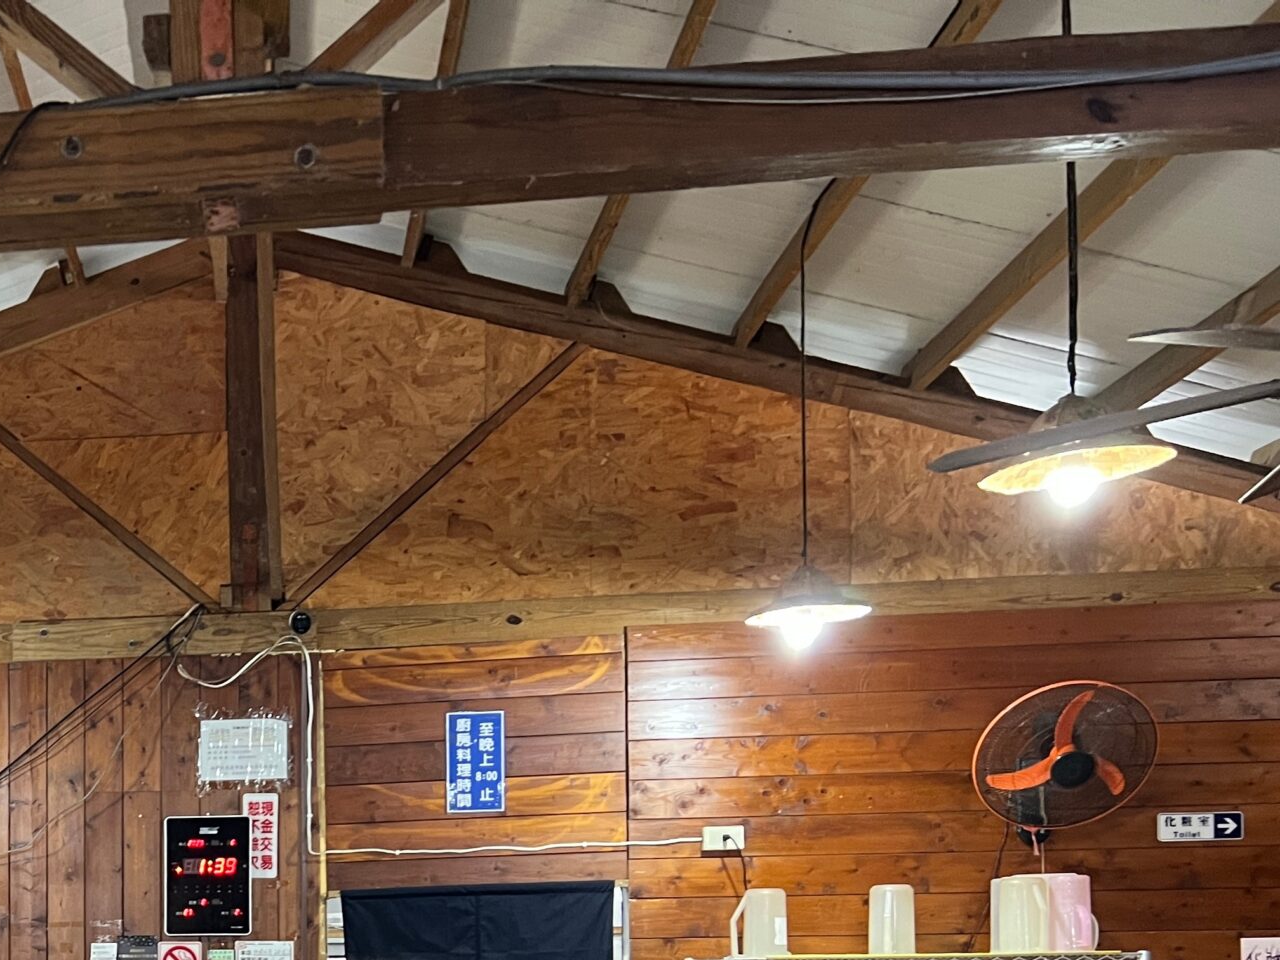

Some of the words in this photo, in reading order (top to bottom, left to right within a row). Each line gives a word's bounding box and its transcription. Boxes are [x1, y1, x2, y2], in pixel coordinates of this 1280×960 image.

[260, 801, 275, 871] 現金交易
[1172, 831, 1201, 839] Toilet
